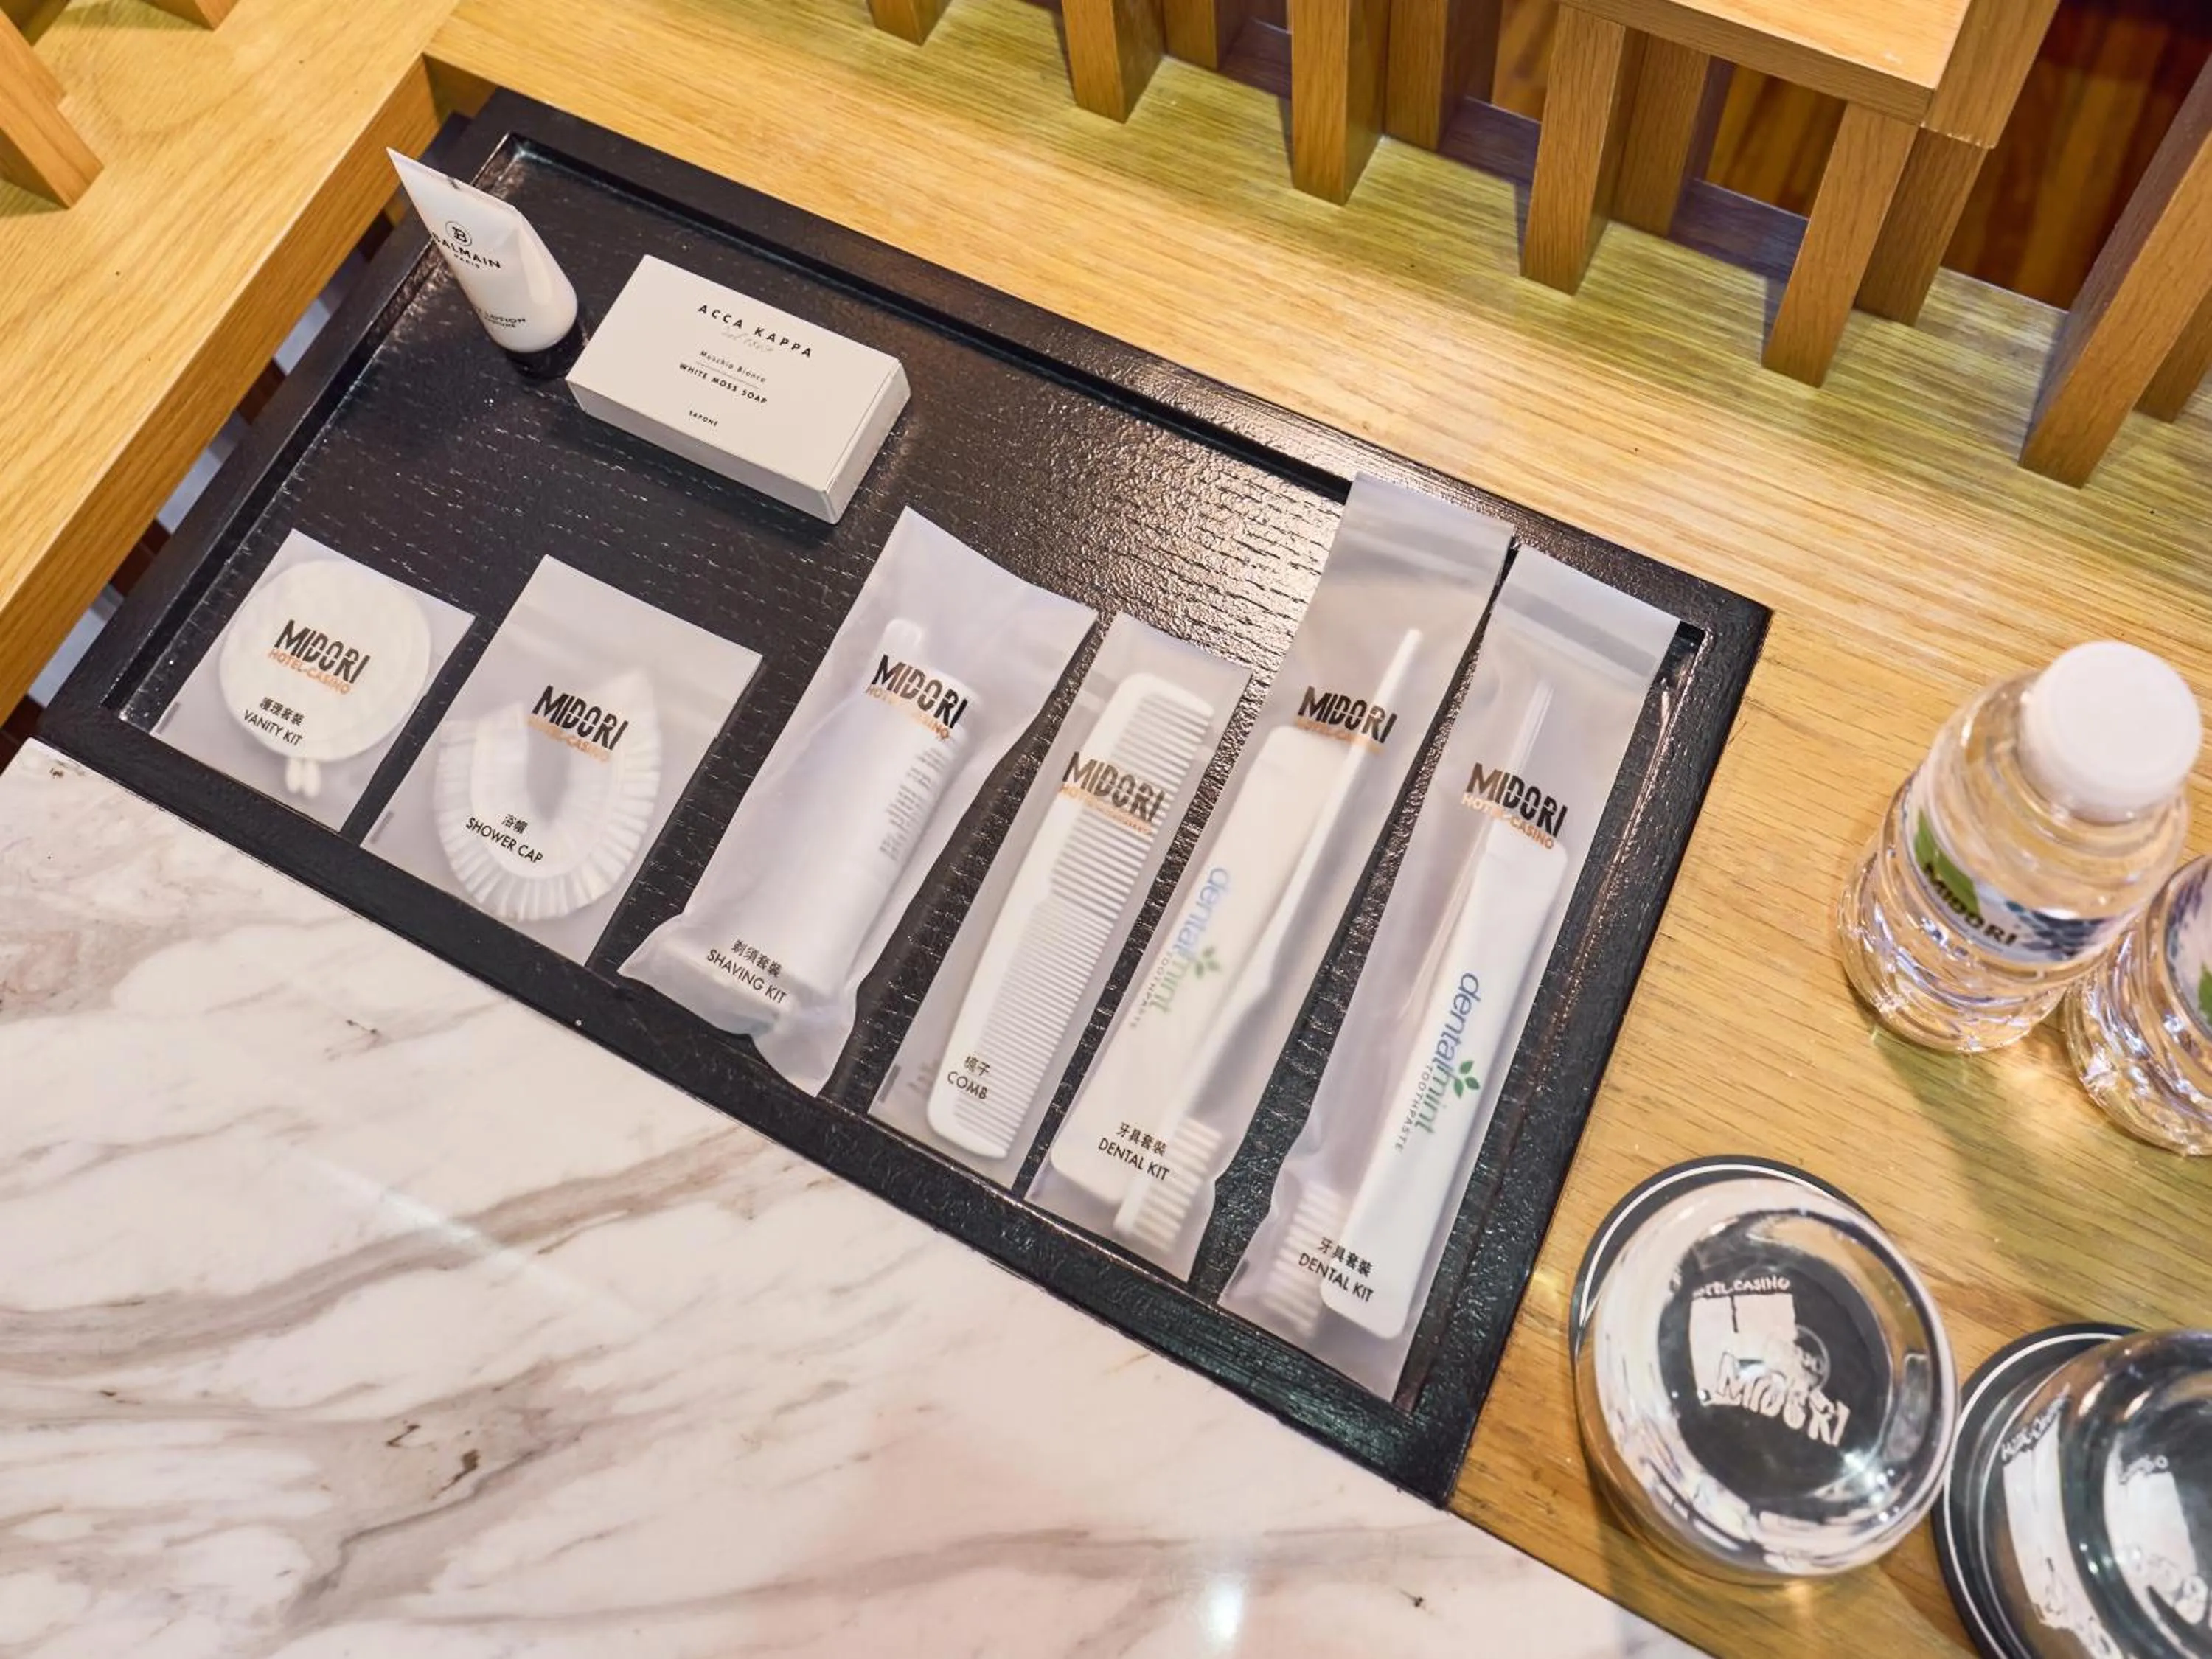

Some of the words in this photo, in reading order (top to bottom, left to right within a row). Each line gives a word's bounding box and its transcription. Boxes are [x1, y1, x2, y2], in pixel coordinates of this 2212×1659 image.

[698, 305, 742, 329] ACCA
[754, 327, 812, 358] KAPPA
[679, 362, 707, 379] WHITE
[712, 377, 738, 392] MOSS
[741, 389, 767, 403] SOAP
[274, 619, 371, 684] MIDORI
[532, 684, 629, 751] MIDORI
[871, 654, 968, 729] MIDORI
[1298, 686, 1397, 744] MIDORI
[244, 709, 284, 737] VANITY
[283, 728, 303, 746] KIT
[1062, 751, 1165, 823] MIDORI
[1466, 762, 1568, 838] MIDORI
[465, 817, 517, 851] SHOWER
[518, 844, 543, 863] CAP
[501, 813, 528, 834] 浴帽
[707, 948, 765, 990] SHAVING
[765, 984, 787, 1004] KIT
[947, 1071, 988, 1099] COMB
[1395, 1063, 1433, 1151] TOOTHPASTE
[1098, 1138, 1144, 1169] DENTAL
[1147, 1161, 1170, 1180] KIT
[1298, 1252, 1349, 1290] DENTAL
[1352, 1281, 1374, 1302] KIT
